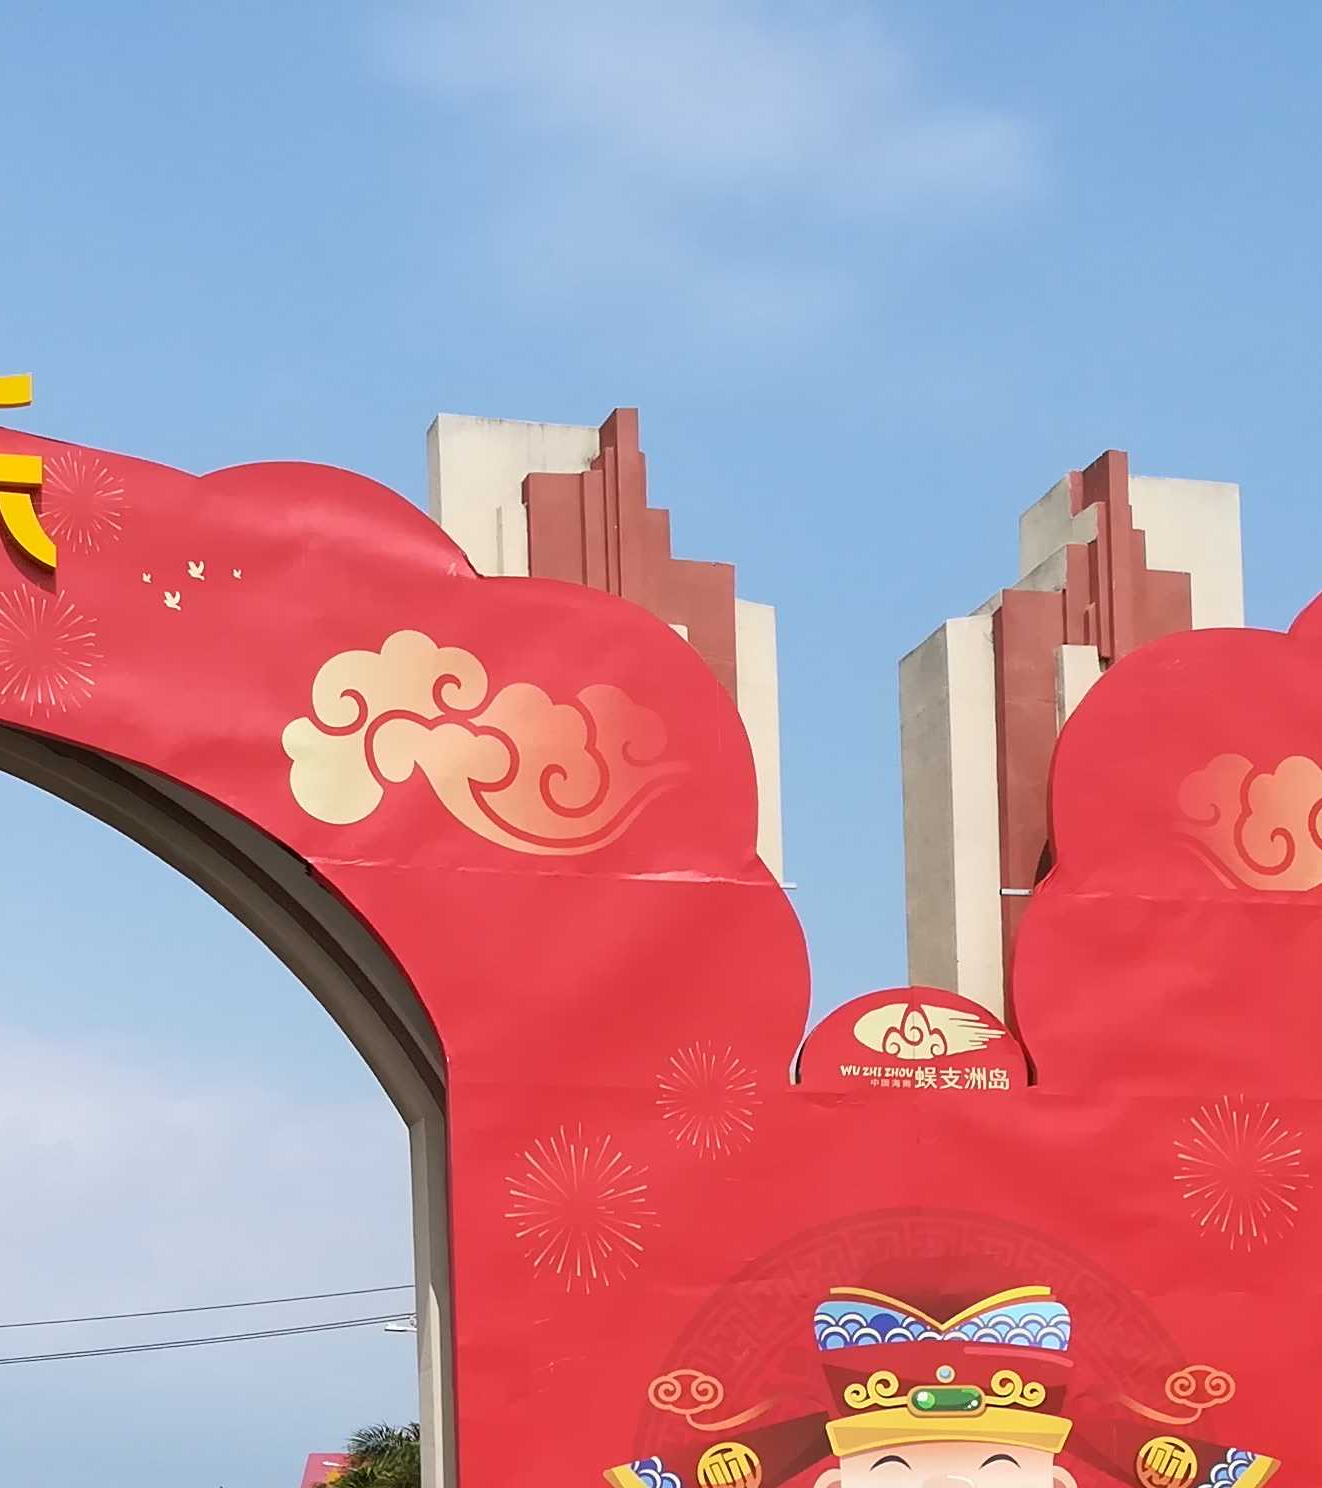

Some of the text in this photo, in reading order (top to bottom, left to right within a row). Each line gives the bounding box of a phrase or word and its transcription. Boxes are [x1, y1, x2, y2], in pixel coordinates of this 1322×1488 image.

[840, 1065, 860, 1077] WU
[914, 1066, 1010, 1090] 蜈支洲岛
